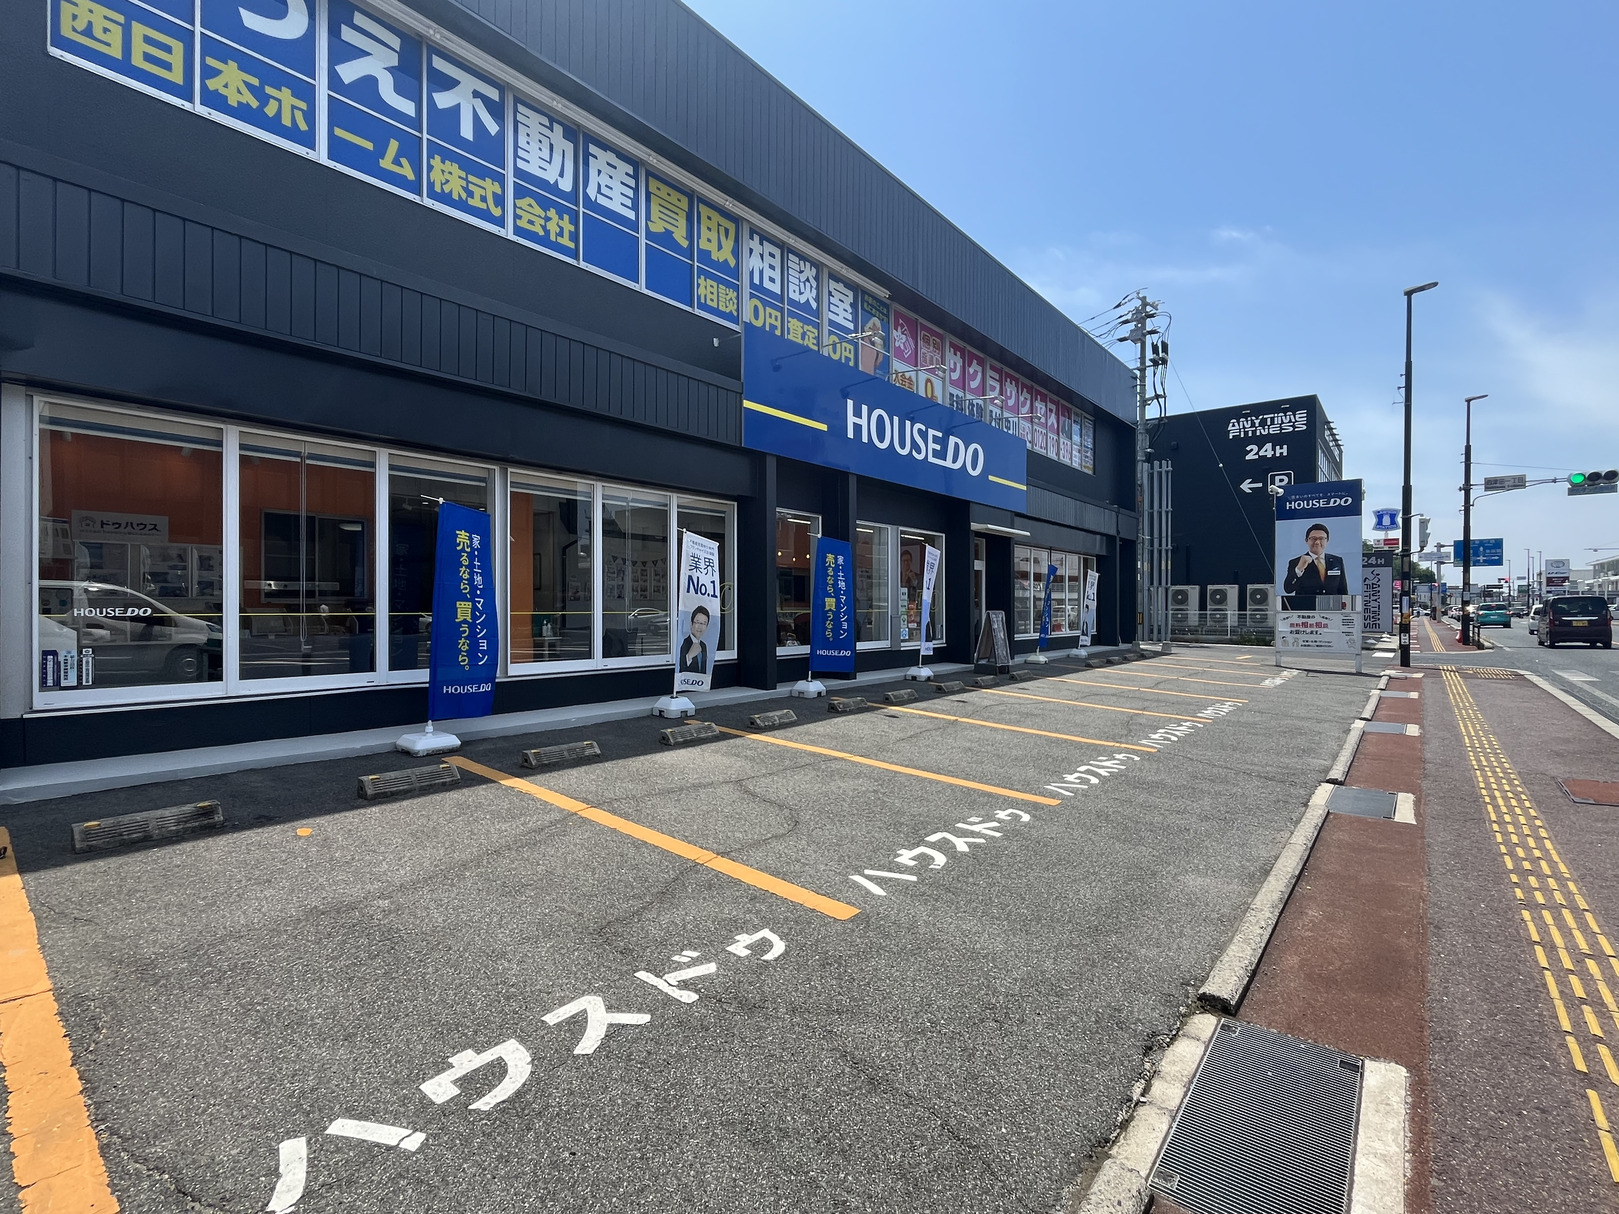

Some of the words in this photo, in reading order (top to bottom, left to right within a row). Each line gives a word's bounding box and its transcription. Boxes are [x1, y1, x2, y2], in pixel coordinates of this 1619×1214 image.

[60, 0, 576, 248] 西日本ホーム株式会社
[947, 348, 1057, 429] サクラサクセス
[1228, 410, 1307, 430] ANYTIME
[1229, 421, 1307, 439] FITNESS
[1245, 443, 1288, 460] 24H
[100, 519, 160, 532] ドゥハウス
[689, 552, 717, 577] 業界
[1362, 557, 1385, 565] 24H
[455, 529, 473, 671] 売るなら、買うなら。
[472, 534, 488, 665] 家・土地・マンション
[686, 574, 718, 599] No.1
[837, 555, 848, 639] 家・土地・マンション
[1363, 584, 1371, 629] FITNESS
[1371, 583, 1380, 629] ANYTIME
[1138, 720, 1204, 748] ハウスドゥ
[1044, 753, 1140, 796] ハウスドゥ
[848, 808, 1031, 896] ハウスドゥ
[267, 928, 787, 1212] ハウスドゥ
